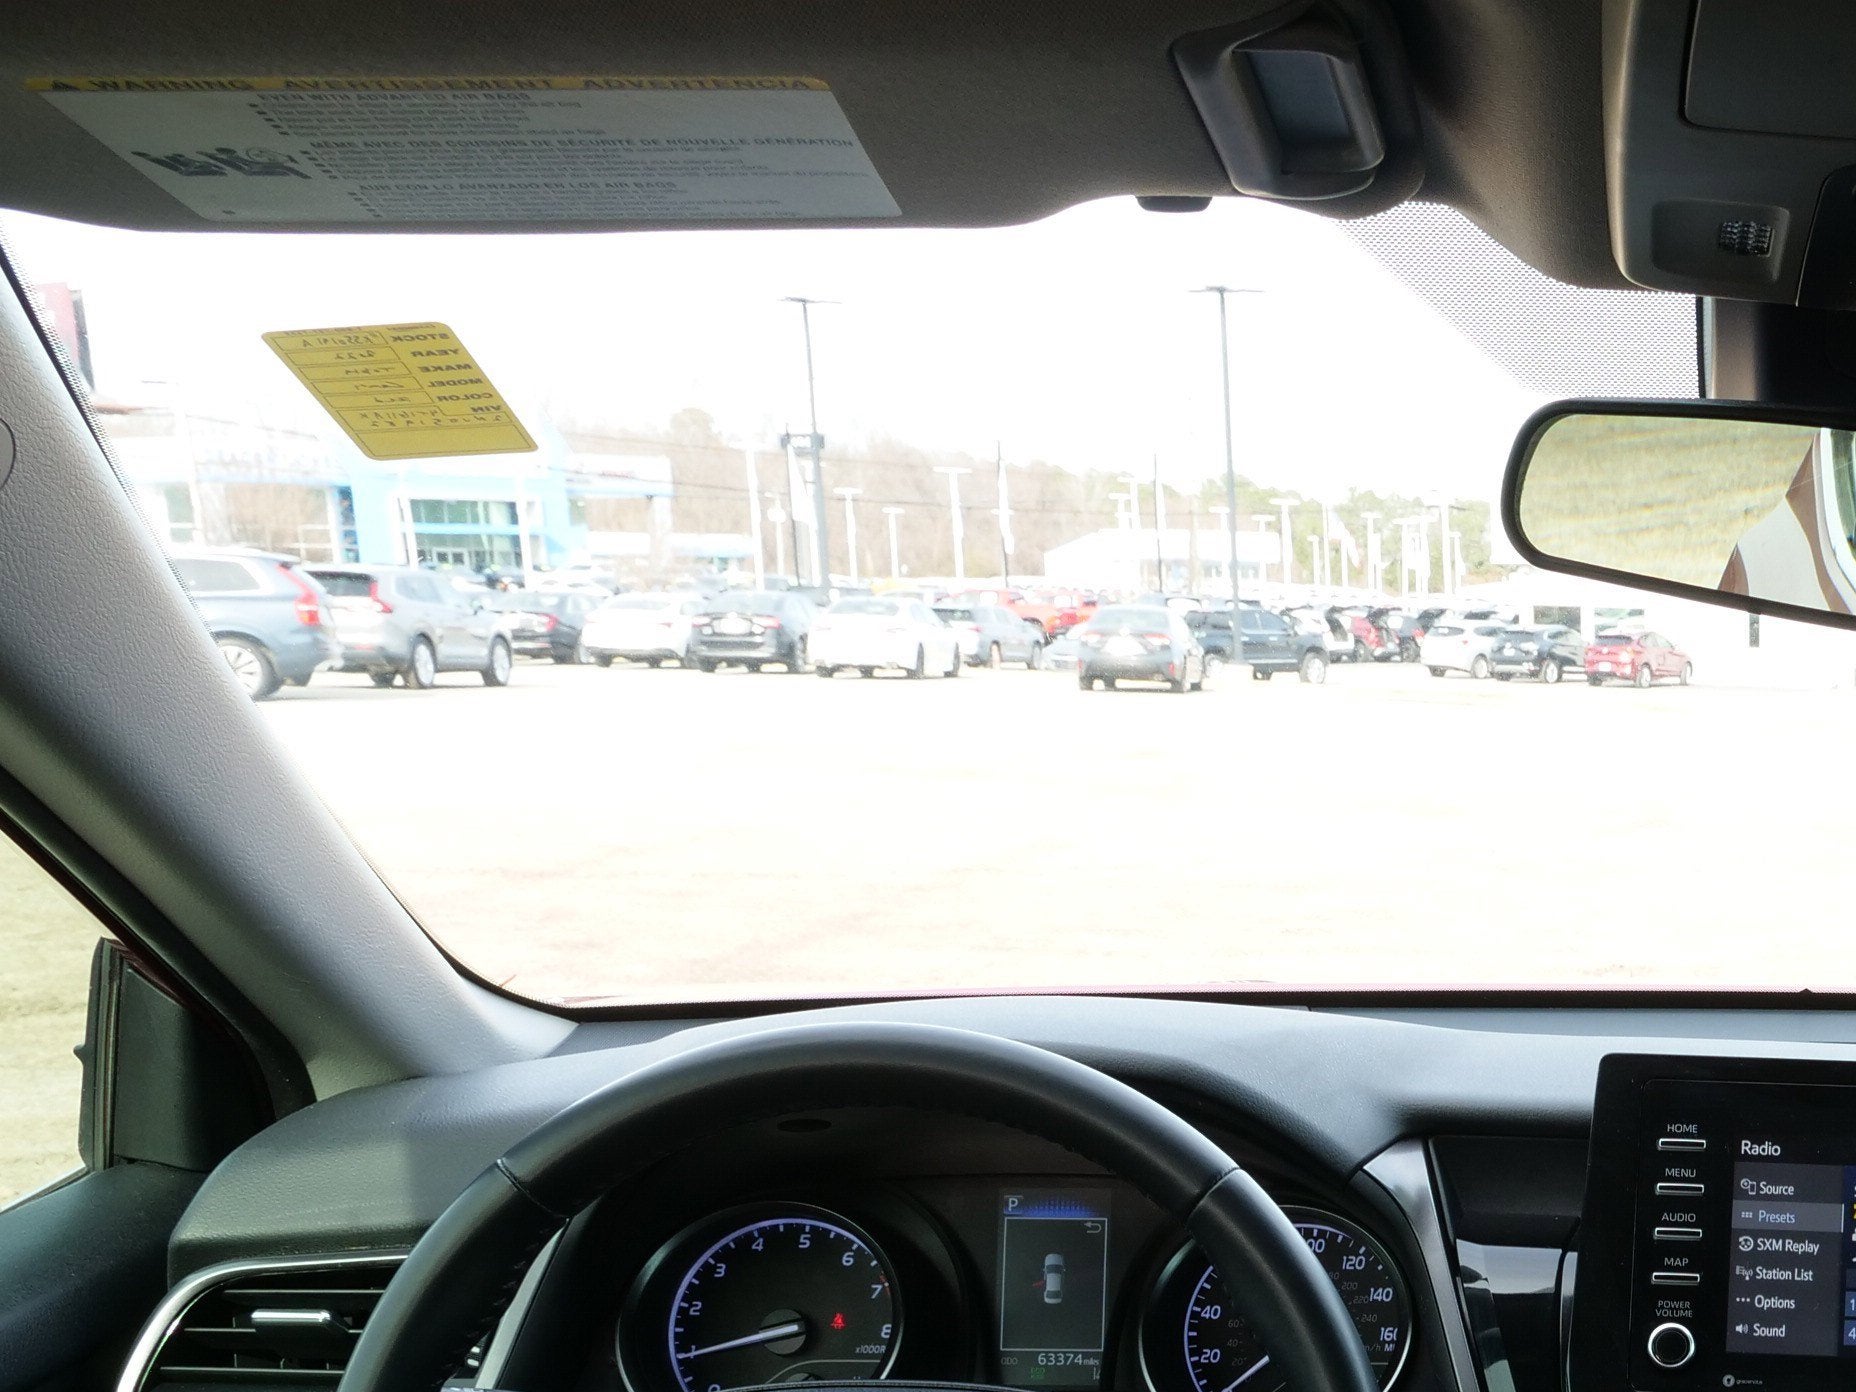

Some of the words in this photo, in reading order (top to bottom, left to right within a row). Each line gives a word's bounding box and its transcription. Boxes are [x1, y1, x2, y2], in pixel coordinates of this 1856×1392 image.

[88, 79, 254, 91] WARNING
[1667, 1123, 1698, 1134] HOME
[1741, 1140, 1781, 1156] Radio
[1665, 1168, 1697, 1178] MENU
[1759, 1181, 1795, 1196] Source
[1008, 1197, 1019, 1212] P
[1661, 1212, 1697, 1223] AUDIO
[1758, 1210, 1796, 1224] Presets
[751, 1237, 764, 1251] 4
[798, 1234, 811, 1249] 5
[1757, 1238, 1783, 1251] SXM
[1785, 1239, 1820, 1255] Replay
[842, 1252, 854, 1266] 6
[1342, 1255, 1366, 1270] 120
[1664, 1257, 1689, 1267] MAP
[713, 1263, 726, 1277] 3
[1756, 1266, 1792, 1281] Station
[1795, 1268, 1813, 1282] List
[870, 1284, 883, 1299] 7
[1341, 1281, 1358, 1290] 200
[1369, 1287, 1393, 1302] 140
[688, 1301, 702, 1315] 2
[1658, 1300, 1691, 1309] POWER
[1754, 1295, 1796, 1311] Options
[1849, 1299, 1856, 1312] 1
[1200, 1305, 1221, 1320] 40
[1361, 1314, 1377, 1323] 240
[1655, 1309, 1693, 1318] VOLUME
[880, 1323, 892, 1339] 8
[1228, 1320, 1240, 1329] 60
[1753, 1323, 1786, 1337] Sound
[1848, 1328, 1856, 1341] 4
[1037, 1353, 1083, 1366] 63374
[1200, 1349, 1220, 1364] 20
